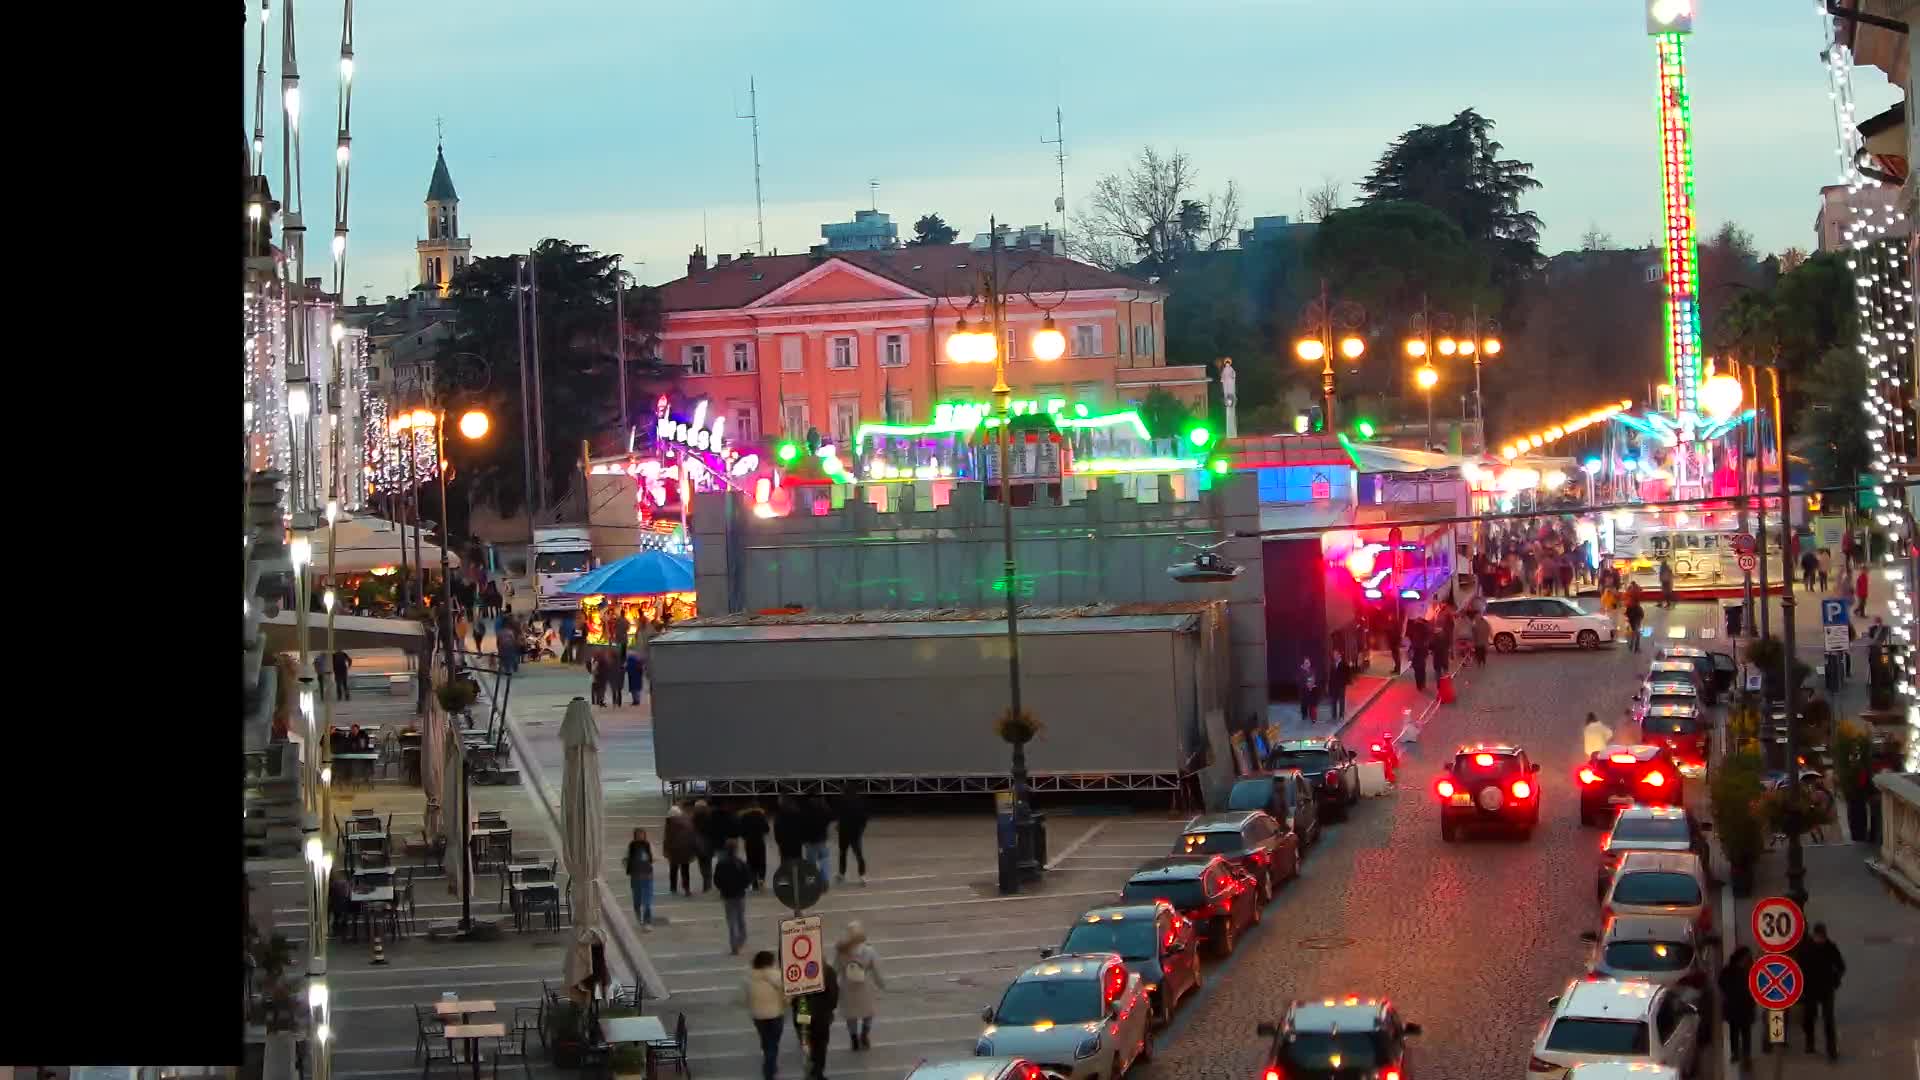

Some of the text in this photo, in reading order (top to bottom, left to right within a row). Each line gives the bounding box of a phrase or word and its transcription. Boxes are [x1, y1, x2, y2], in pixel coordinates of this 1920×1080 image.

[1742, 558, 1752, 567] 20
[1826, 602, 1842, 622] P
[1762, 911, 1791, 937] 30
